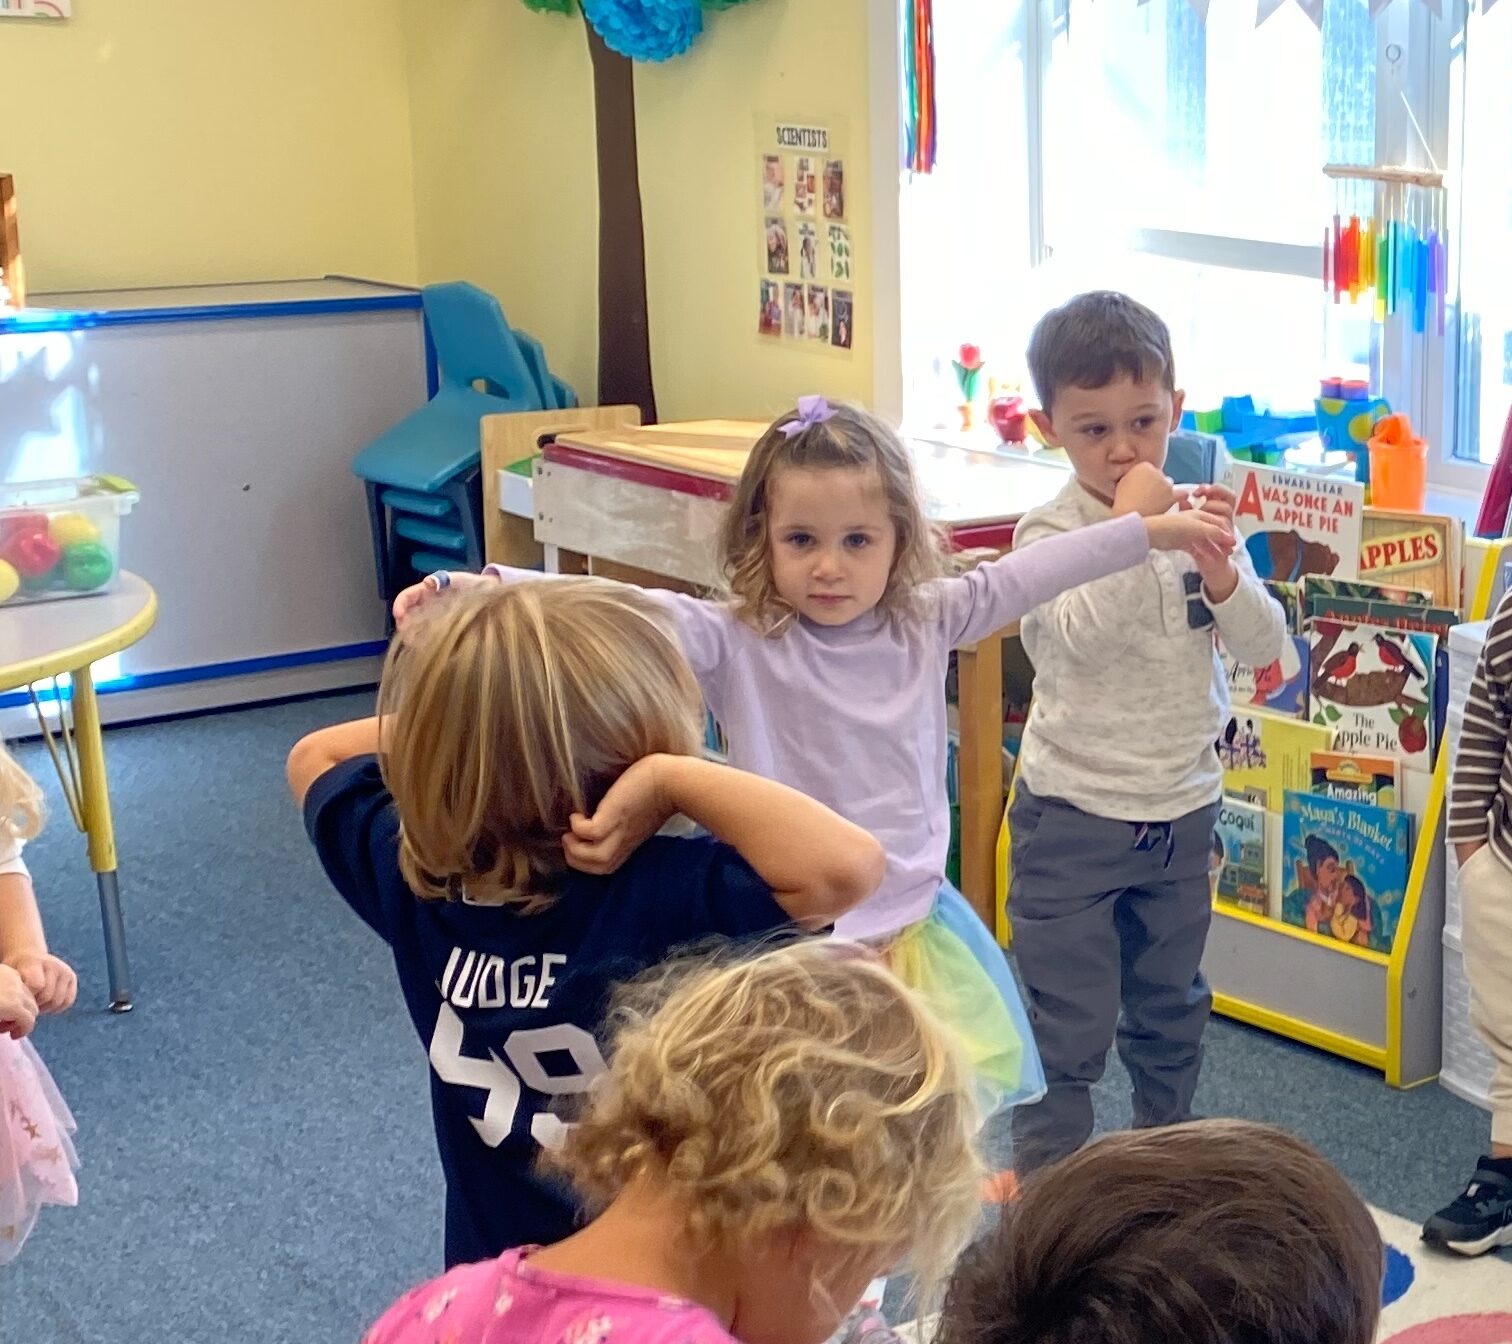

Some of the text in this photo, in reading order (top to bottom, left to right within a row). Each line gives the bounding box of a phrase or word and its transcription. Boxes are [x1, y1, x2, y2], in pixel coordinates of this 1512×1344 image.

[776, 126, 827, 148] SCIENTISTS
[1272, 474, 1344, 496] EDWARD LEAR
[1235, 471, 1354, 523] A WAS ONCE AN
[1273, 507, 1340, 535] APPLE PIE
[1353, 712, 1375, 728] The
[1376, 732, 1398, 751] Pie
[1326, 783, 1377, 807] Amazing
[1301, 802, 1345, 828] Maya's
[1347, 810, 1394, 852] Blanket
